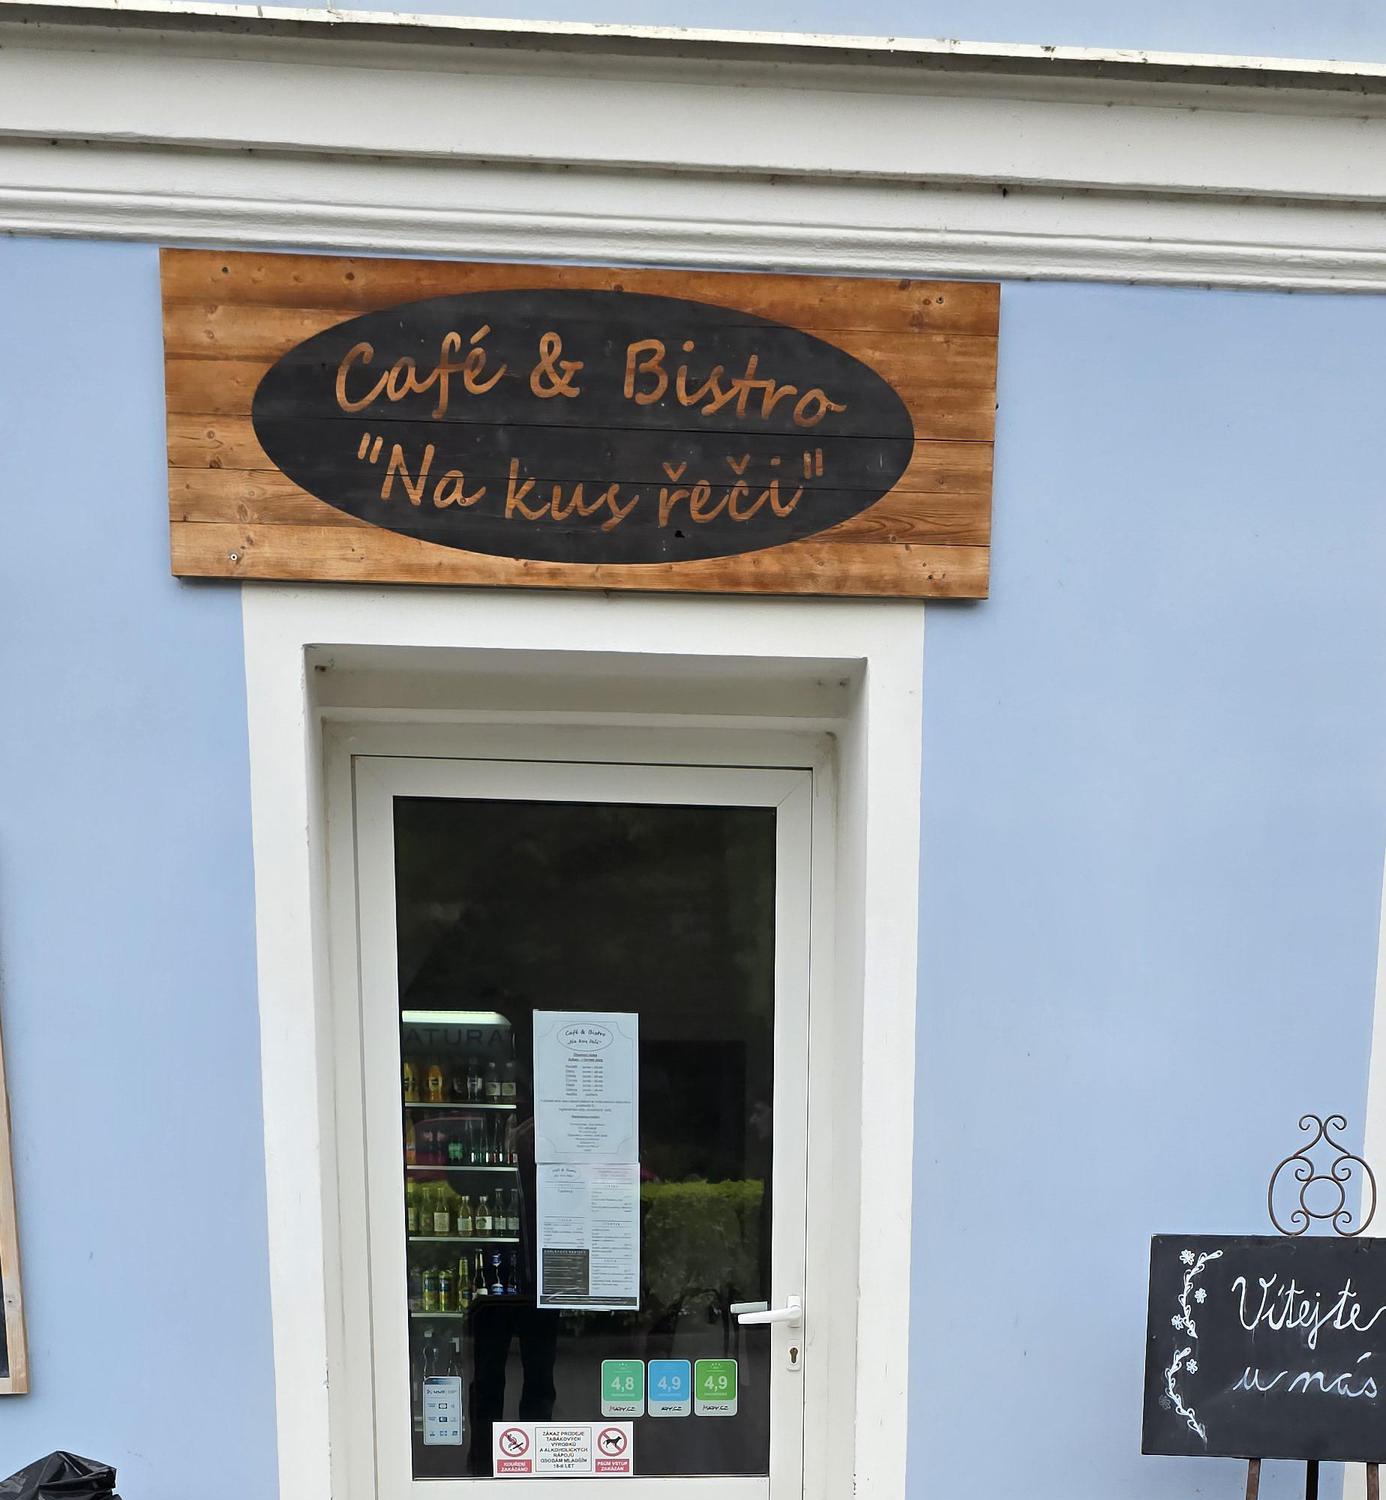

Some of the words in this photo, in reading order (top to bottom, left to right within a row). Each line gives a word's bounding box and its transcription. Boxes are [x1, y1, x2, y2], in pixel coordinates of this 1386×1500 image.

[335, 325, 507, 421] Café
[530, 331, 580, 398] &
[624, 339, 848, 427] Bistro
[356, 433, 487, 510] "Na
[504, 458, 640, 532] kus
[658, 447, 825, 528] řeči"
[1230, 1273, 1386, 1350] Vítejte
[611, 1376, 635, 1392] 4,8
[657, 1376, 681, 1392] 4,9
[704, 1375, 728, 1392] 4,9
[1232, 1366, 1289, 1391] u
[1288, 1351, 1378, 1399] nás
